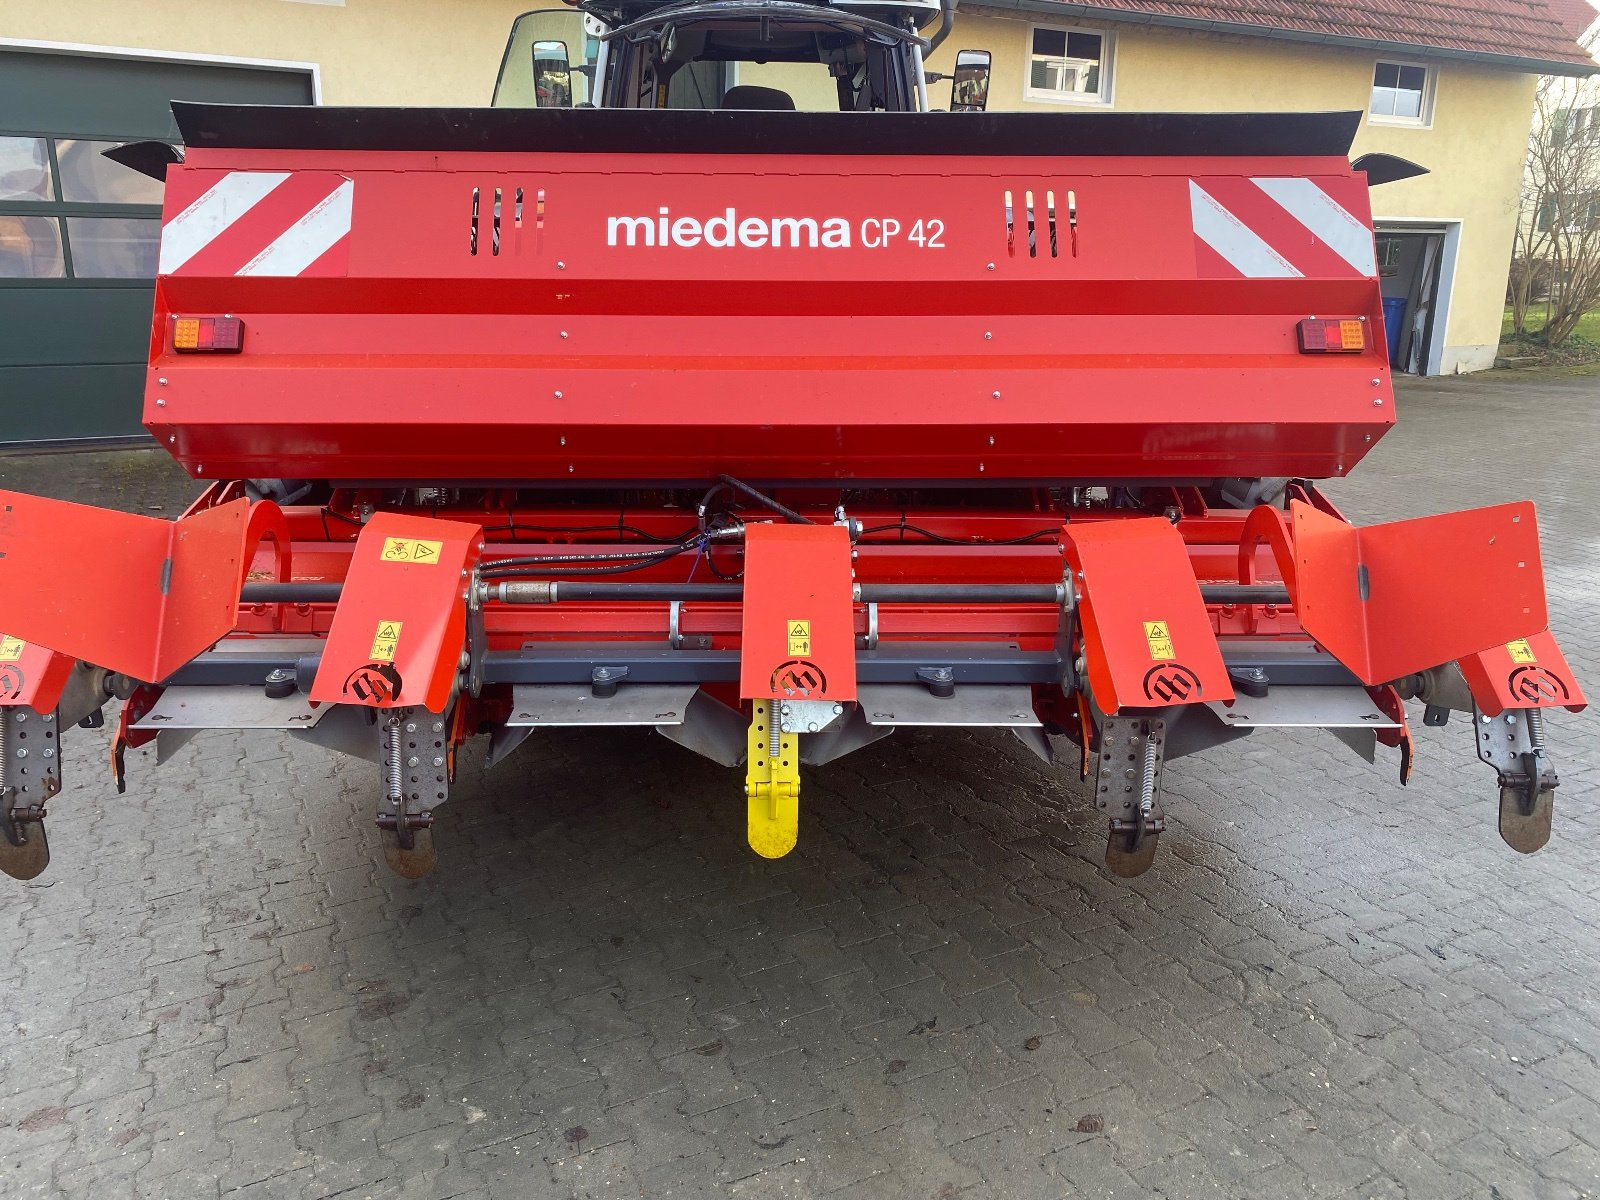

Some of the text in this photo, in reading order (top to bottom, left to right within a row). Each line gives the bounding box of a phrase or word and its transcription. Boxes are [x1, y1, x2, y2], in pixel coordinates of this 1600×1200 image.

[607, 206, 946, 249] miedema CP 42
